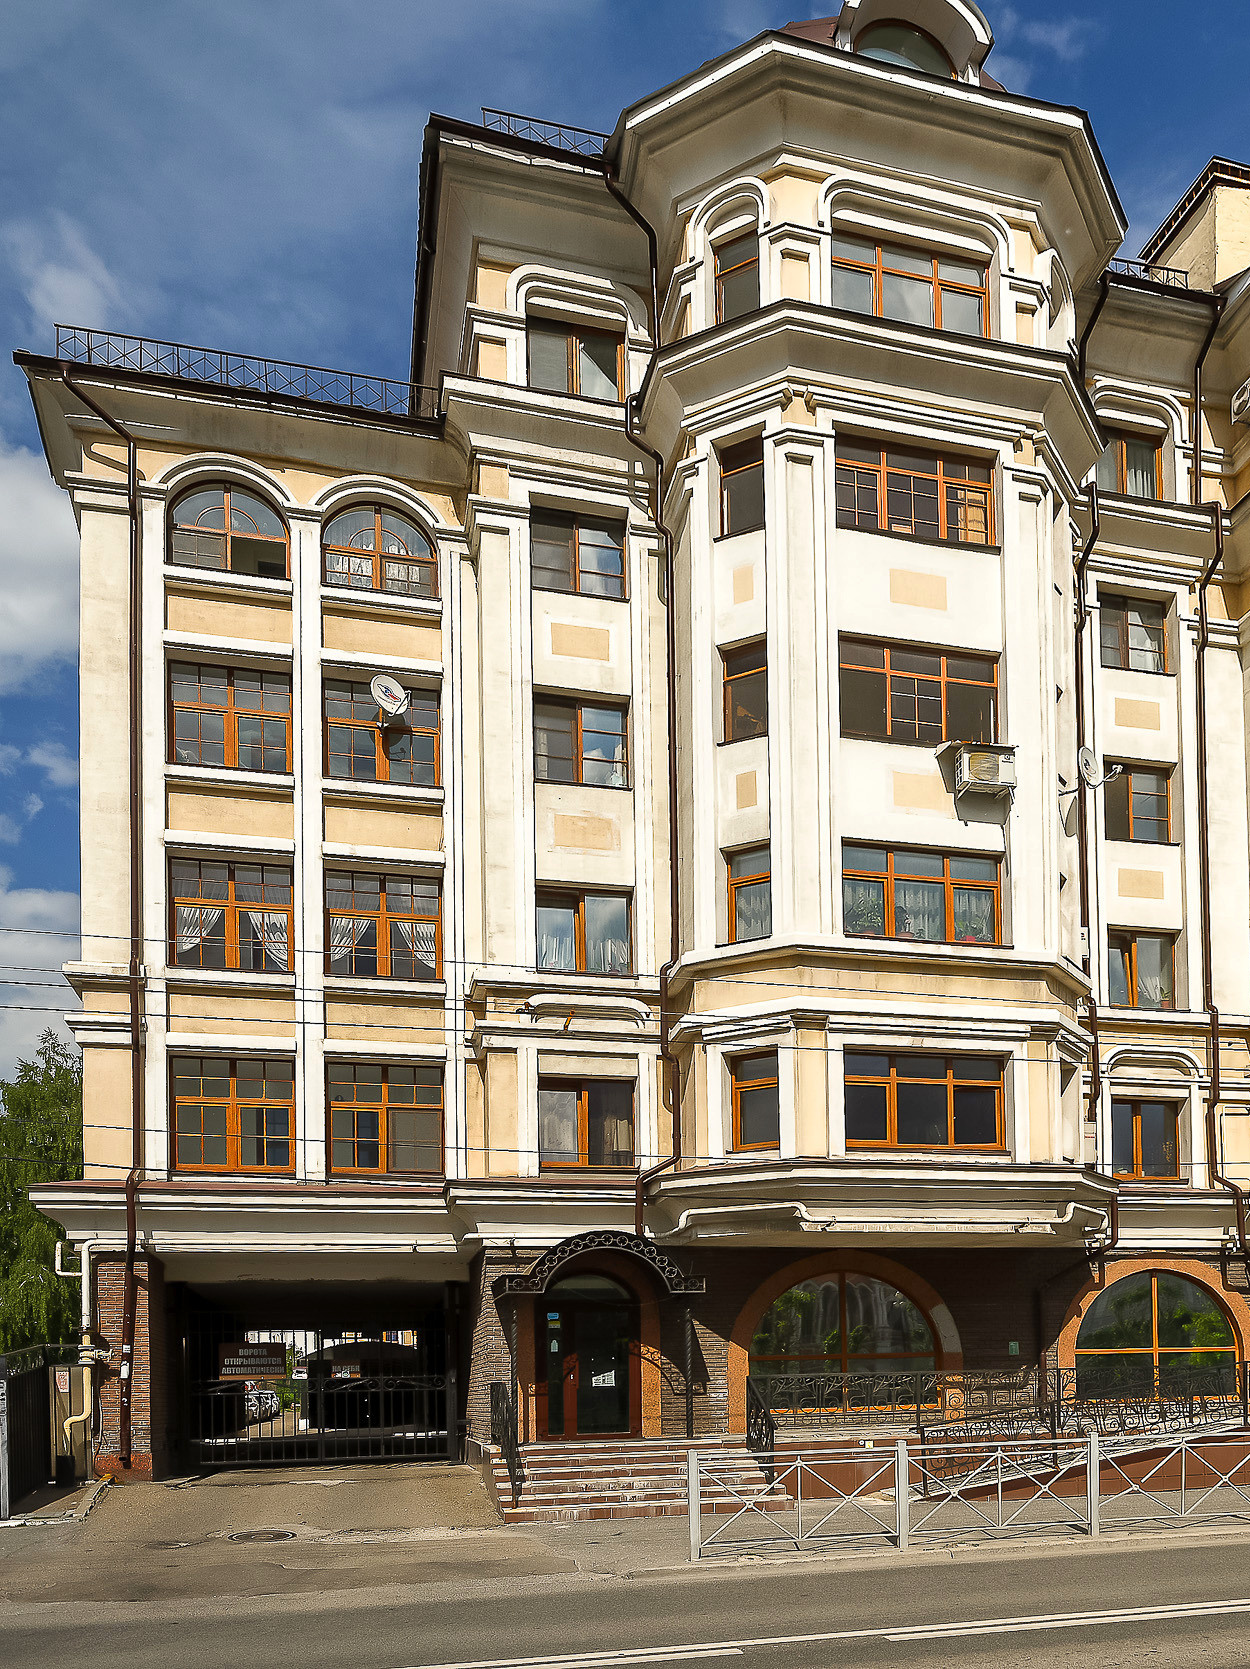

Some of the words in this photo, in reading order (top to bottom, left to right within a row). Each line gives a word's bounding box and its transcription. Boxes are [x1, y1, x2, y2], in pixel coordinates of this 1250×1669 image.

[238, 1348, 268, 1356] ВОРОТА
[224, 1357, 282, 1365] ОТКРЫВАЮТСЯ
[221, 1366, 285, 1374] АВТОМАТИЧЕСКИ
